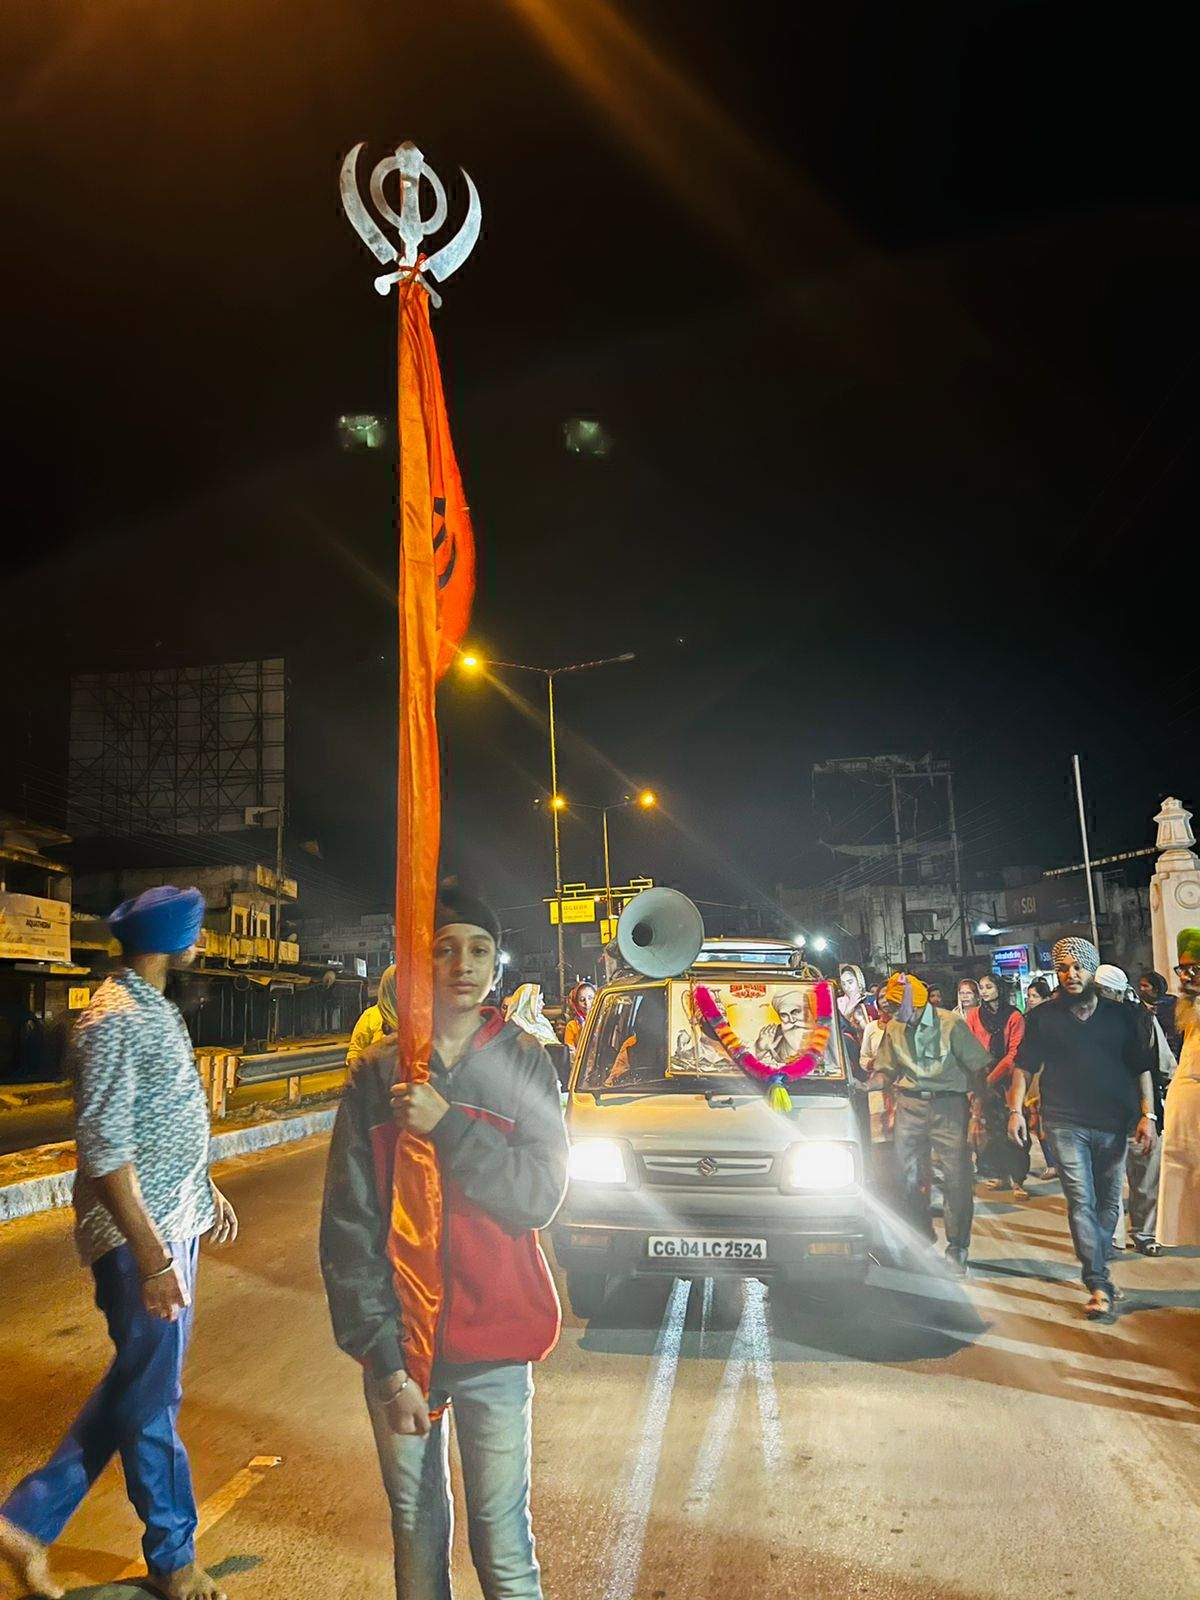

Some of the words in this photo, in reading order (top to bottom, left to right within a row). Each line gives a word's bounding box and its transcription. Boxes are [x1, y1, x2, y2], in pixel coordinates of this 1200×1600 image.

[1021, 896, 1036, 913] SBI
[702, 1242, 721, 1257] LC
[724, 1242, 762, 1258] 2524
